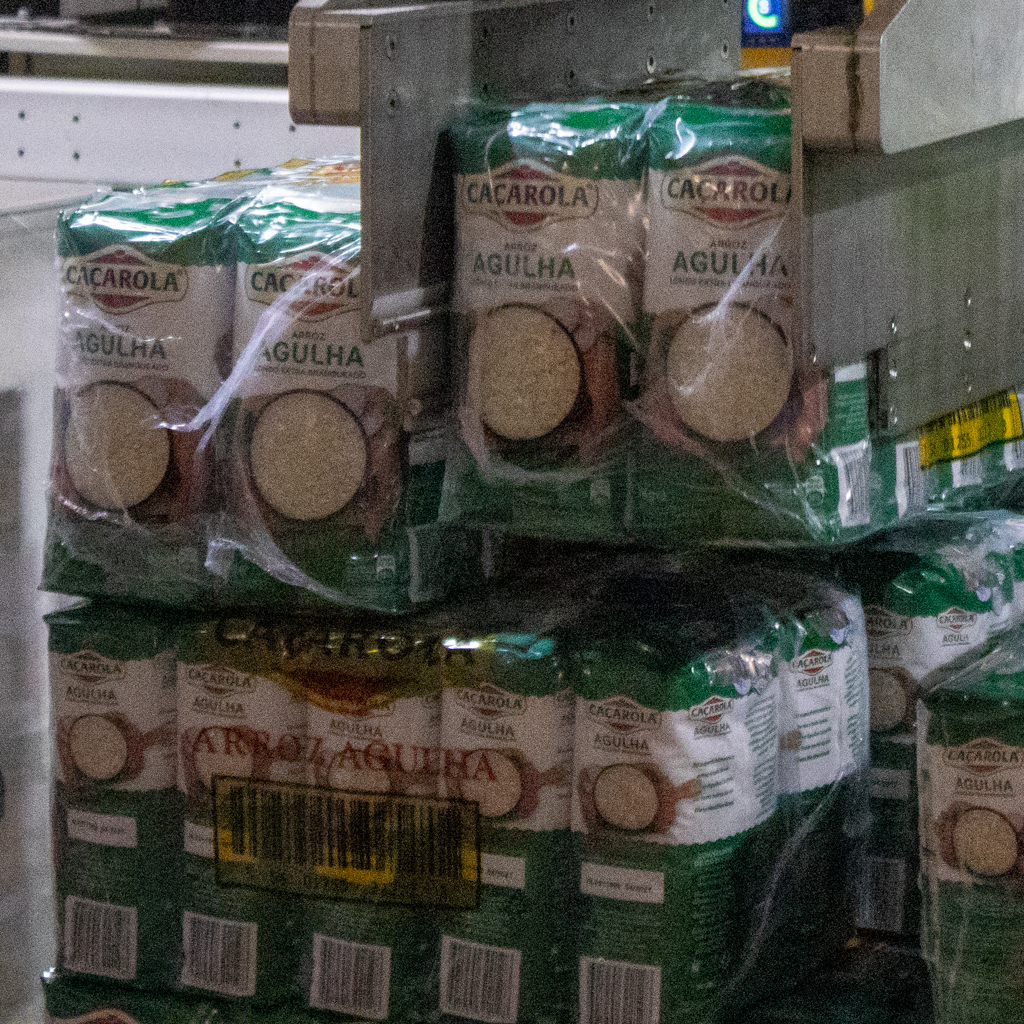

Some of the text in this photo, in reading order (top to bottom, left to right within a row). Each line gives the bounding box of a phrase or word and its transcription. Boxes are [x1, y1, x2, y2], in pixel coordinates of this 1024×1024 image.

[473, 252, 576, 279] AGULHA
[594, 733, 649, 751] AGULHA
[956, 777, 1014, 793] AGULHA
